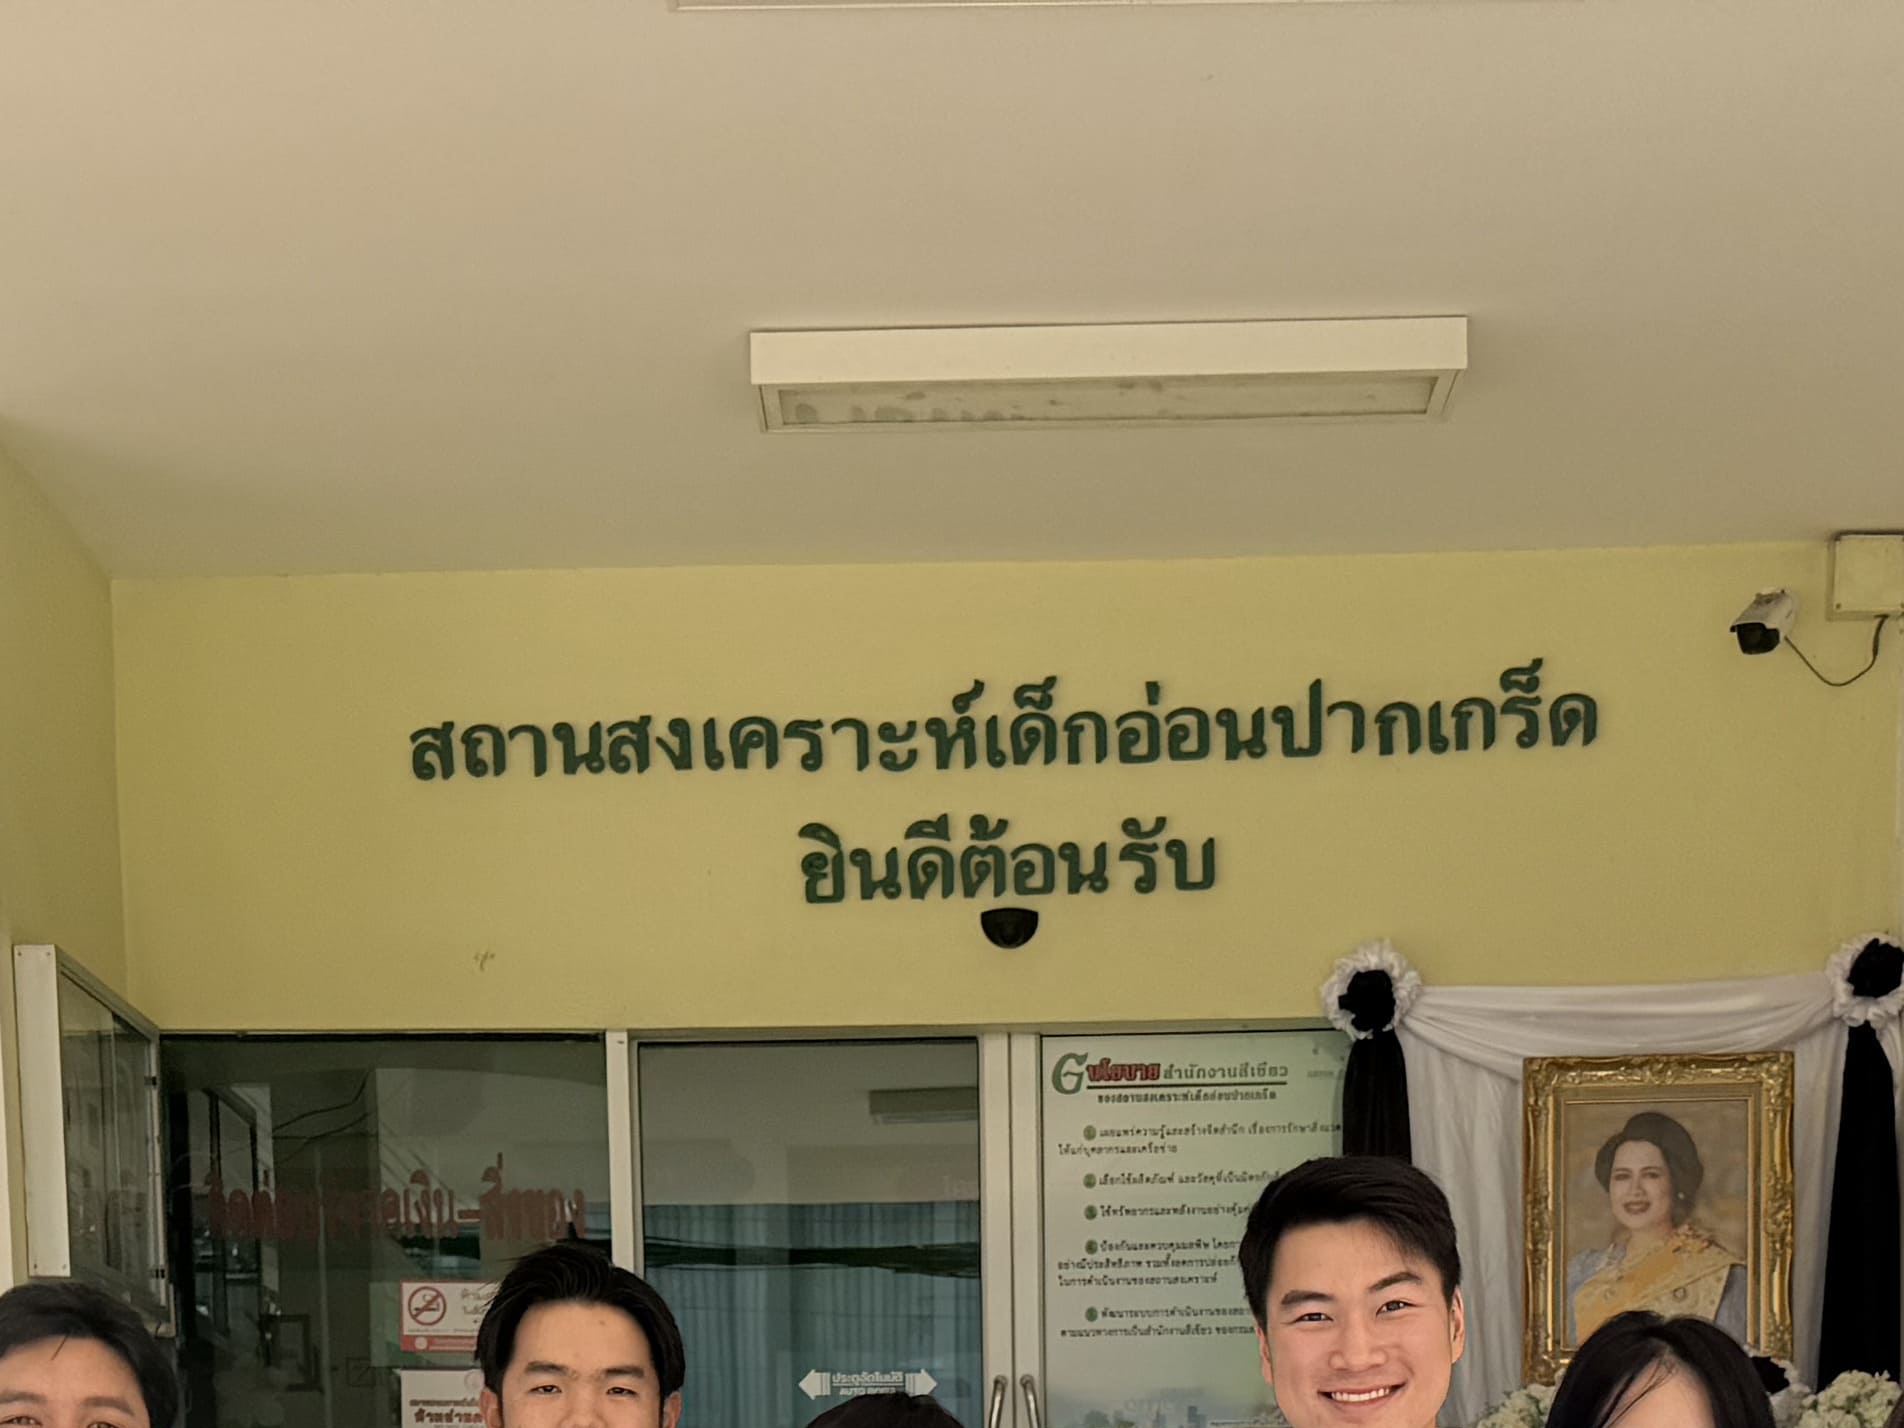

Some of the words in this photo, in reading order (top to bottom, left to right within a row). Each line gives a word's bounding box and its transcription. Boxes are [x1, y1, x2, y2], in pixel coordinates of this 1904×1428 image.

[409, 657, 1602, 782] สถานสงเคราะห์เด็กอ่อนปากเกร็ด
[798, 813, 1217, 905] ยินดีต้อนรับ
